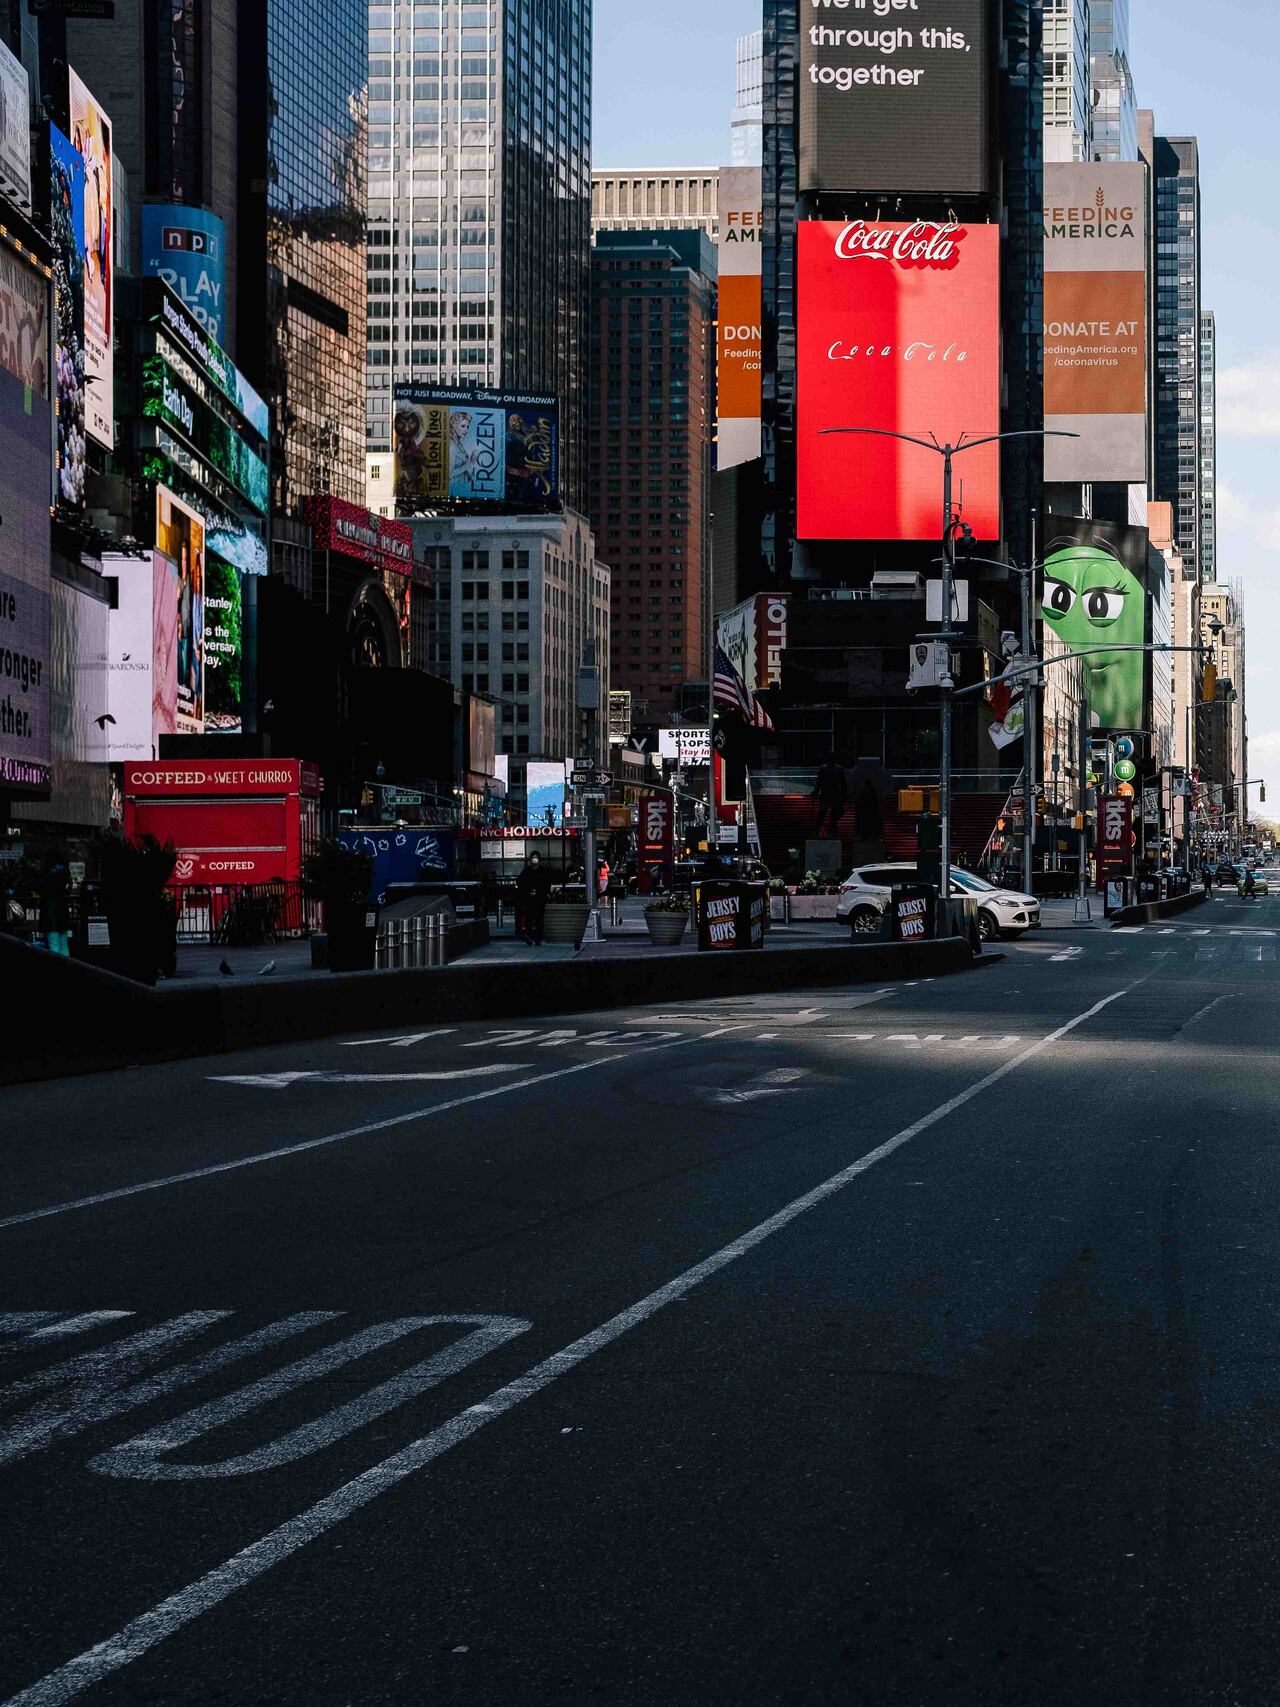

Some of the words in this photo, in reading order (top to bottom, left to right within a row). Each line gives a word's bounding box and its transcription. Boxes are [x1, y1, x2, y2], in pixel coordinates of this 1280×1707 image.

[809, 25, 913, 54] through
[920, 27, 971, 52] this,
[808, 64, 925, 91] together
[169, 232, 216, 252] npr
[1115, 321, 1138, 336] AT
[1043, 344, 1138, 355] eedingAmerica.org
[1055, 357, 1118, 366] /coronavirus
[396, 388, 412, 397] NOT
[414, 389, 430, 398] JUST
[431, 391, 473, 400] BROADWAY,
[503, 395, 515, 403] ON
[516, 396, 556, 405] BROADWAY
[425, 410, 442, 438] KING
[424, 441, 442, 468] LION
[470, 412, 499, 493] FROZEN
[428, 471, 441, 492] THE
[214, 625, 230, 638] the
[204, 640, 237, 655] versary
[1, 694, 32, 738] ther.
[668, 730, 711, 739] SPORTS
[131, 772, 206, 785] COFFEED
[214, 771, 245, 784] SWEET
[248, 770, 293, 784] CHURROS
[648, 801, 668, 841] tkts
[1105, 800, 1126, 841] tkts
[480, 828, 501, 838] NYC
[504, 826, 571, 838] HOTDOGS
[209, 861, 255, 870] COFFEED
[706, 896, 740, 918] JERSEY
[898, 898, 927, 917] JERSEY
[709, 921, 736, 942] BOYS
[900, 919, 925, 936] BOYS
